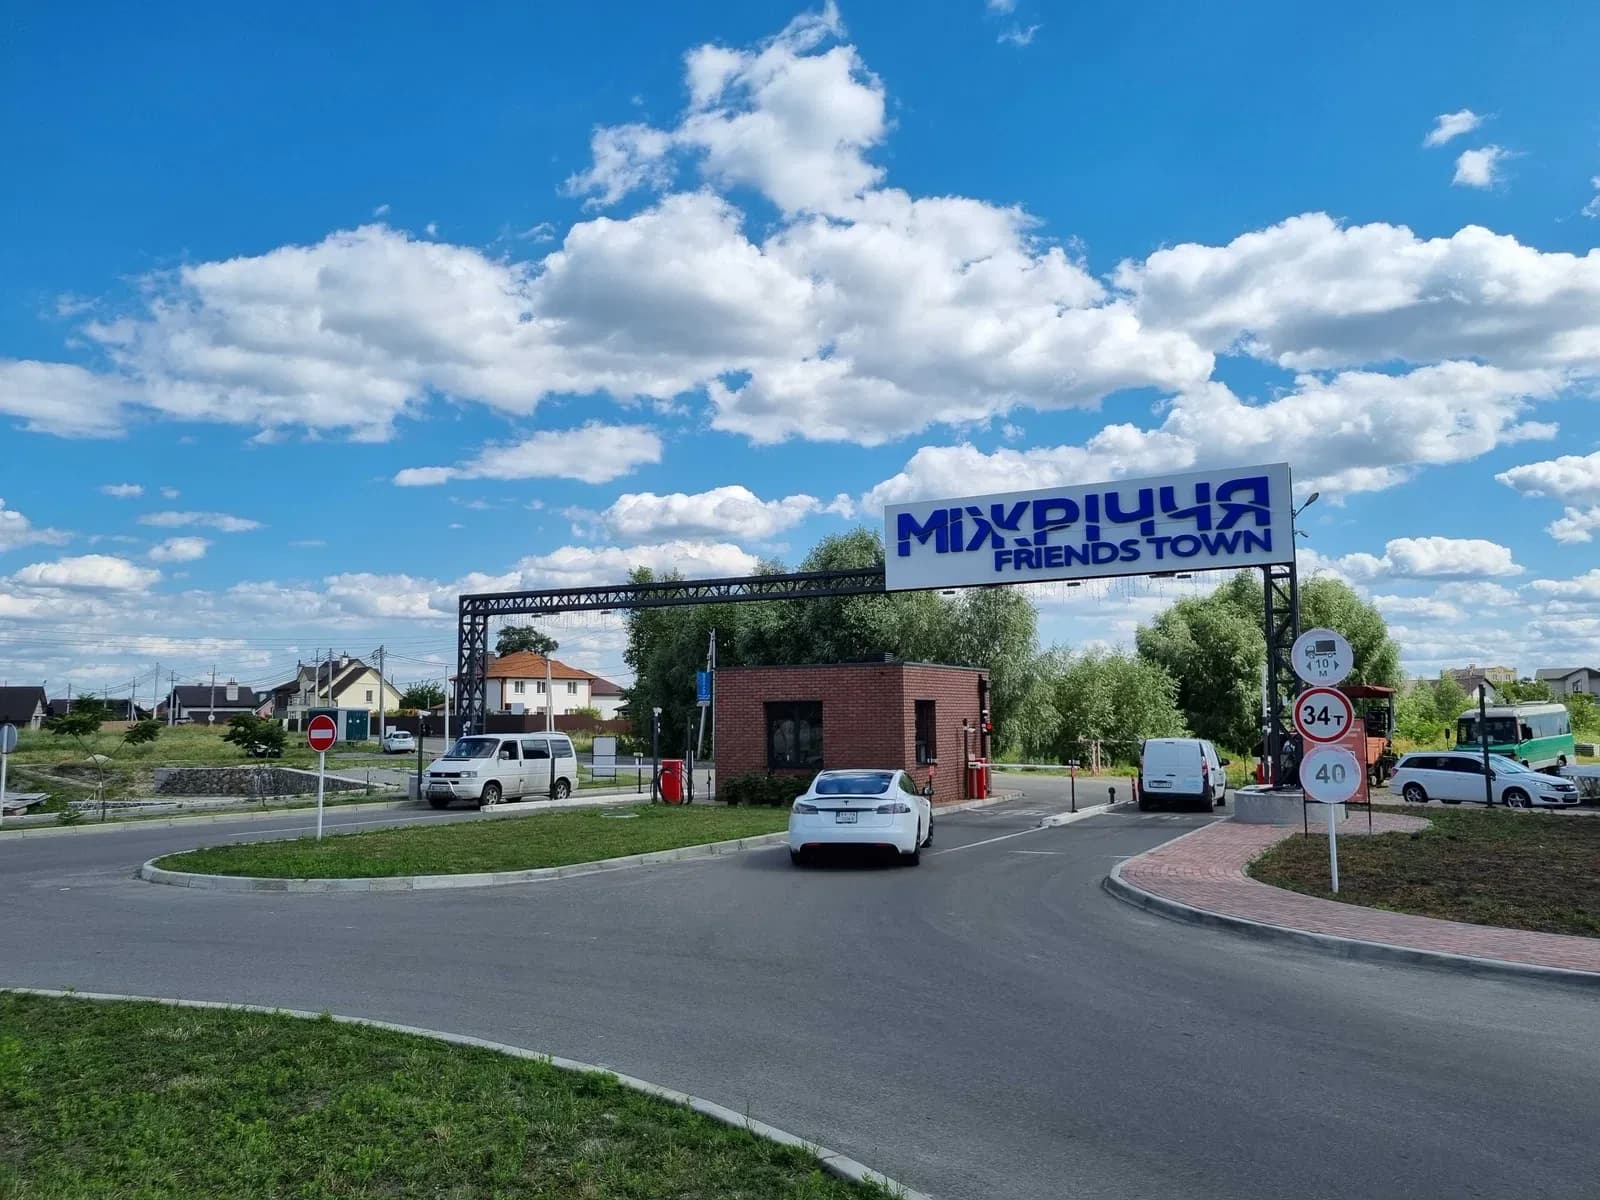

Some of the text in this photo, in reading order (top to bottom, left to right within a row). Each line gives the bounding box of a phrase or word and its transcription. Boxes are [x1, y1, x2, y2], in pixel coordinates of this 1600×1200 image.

[897, 475, 1271, 557] МІЖРІЧЧЯ
[994, 528, 1273, 572] FRIENDS TOWN
[1315, 658, 1329, 669] 10
[1315, 763, 1346, 784] 40
